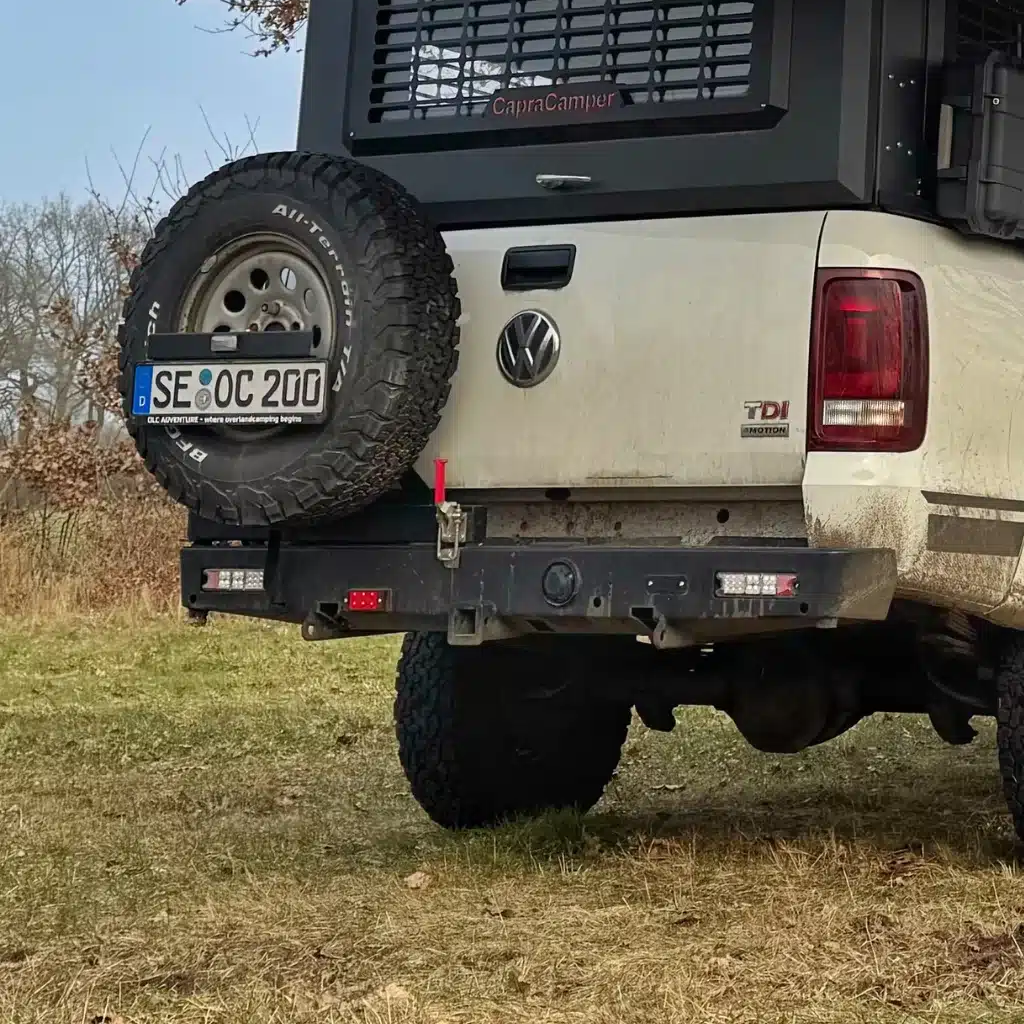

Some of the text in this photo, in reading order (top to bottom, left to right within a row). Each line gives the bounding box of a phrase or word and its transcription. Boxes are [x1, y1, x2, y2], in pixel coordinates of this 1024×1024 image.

[492, 92, 615, 118] CapraCamper
[153, 368, 321, 408] SE OC 200
[138, 395, 146, 407] D
[744, 400, 789, 420] TDI
[161, 416, 199, 424] ADVENTURE
